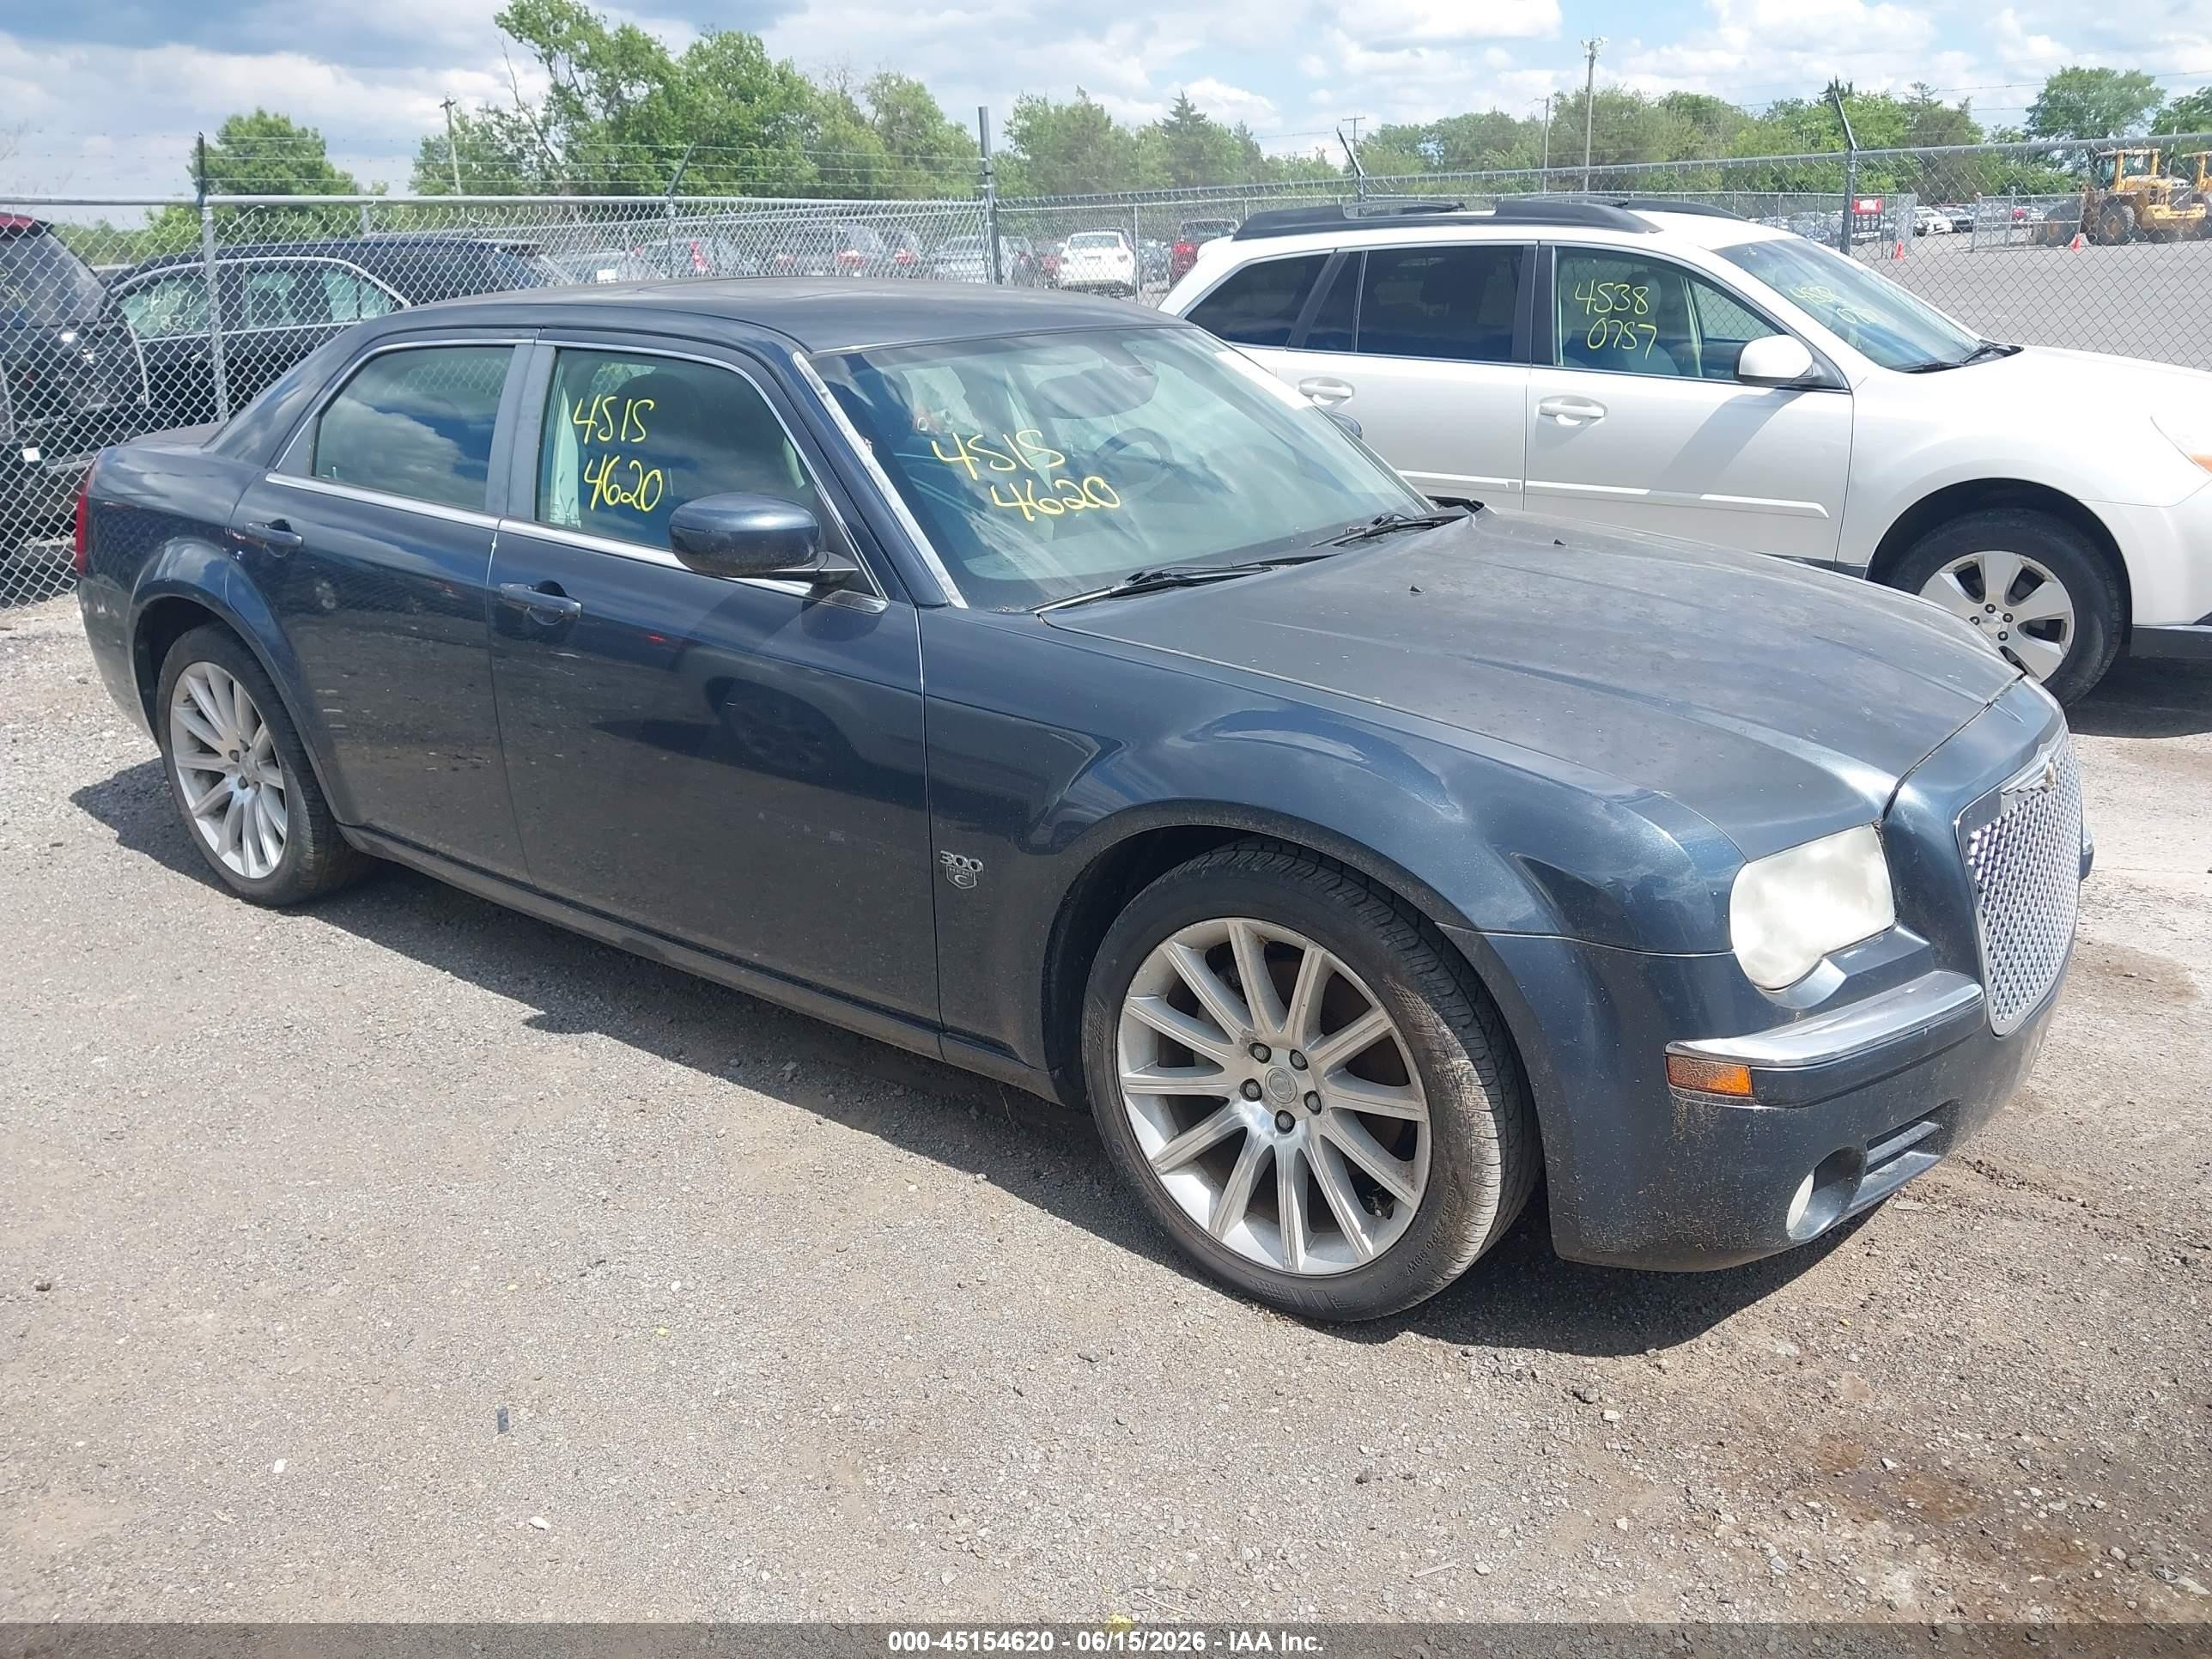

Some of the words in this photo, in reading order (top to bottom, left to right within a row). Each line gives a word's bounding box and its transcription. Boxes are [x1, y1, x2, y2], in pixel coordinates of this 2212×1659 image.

[1573, 279, 1649, 316] 4538
[1586, 317, 1658, 360] 0757
[572, 393, 655, 443] 4515
[931, 428, 1067, 479] 4515
[584, 453, 664, 513] 4620
[990, 474, 1121, 521] 4620
[939, 849, 984, 872] 300
